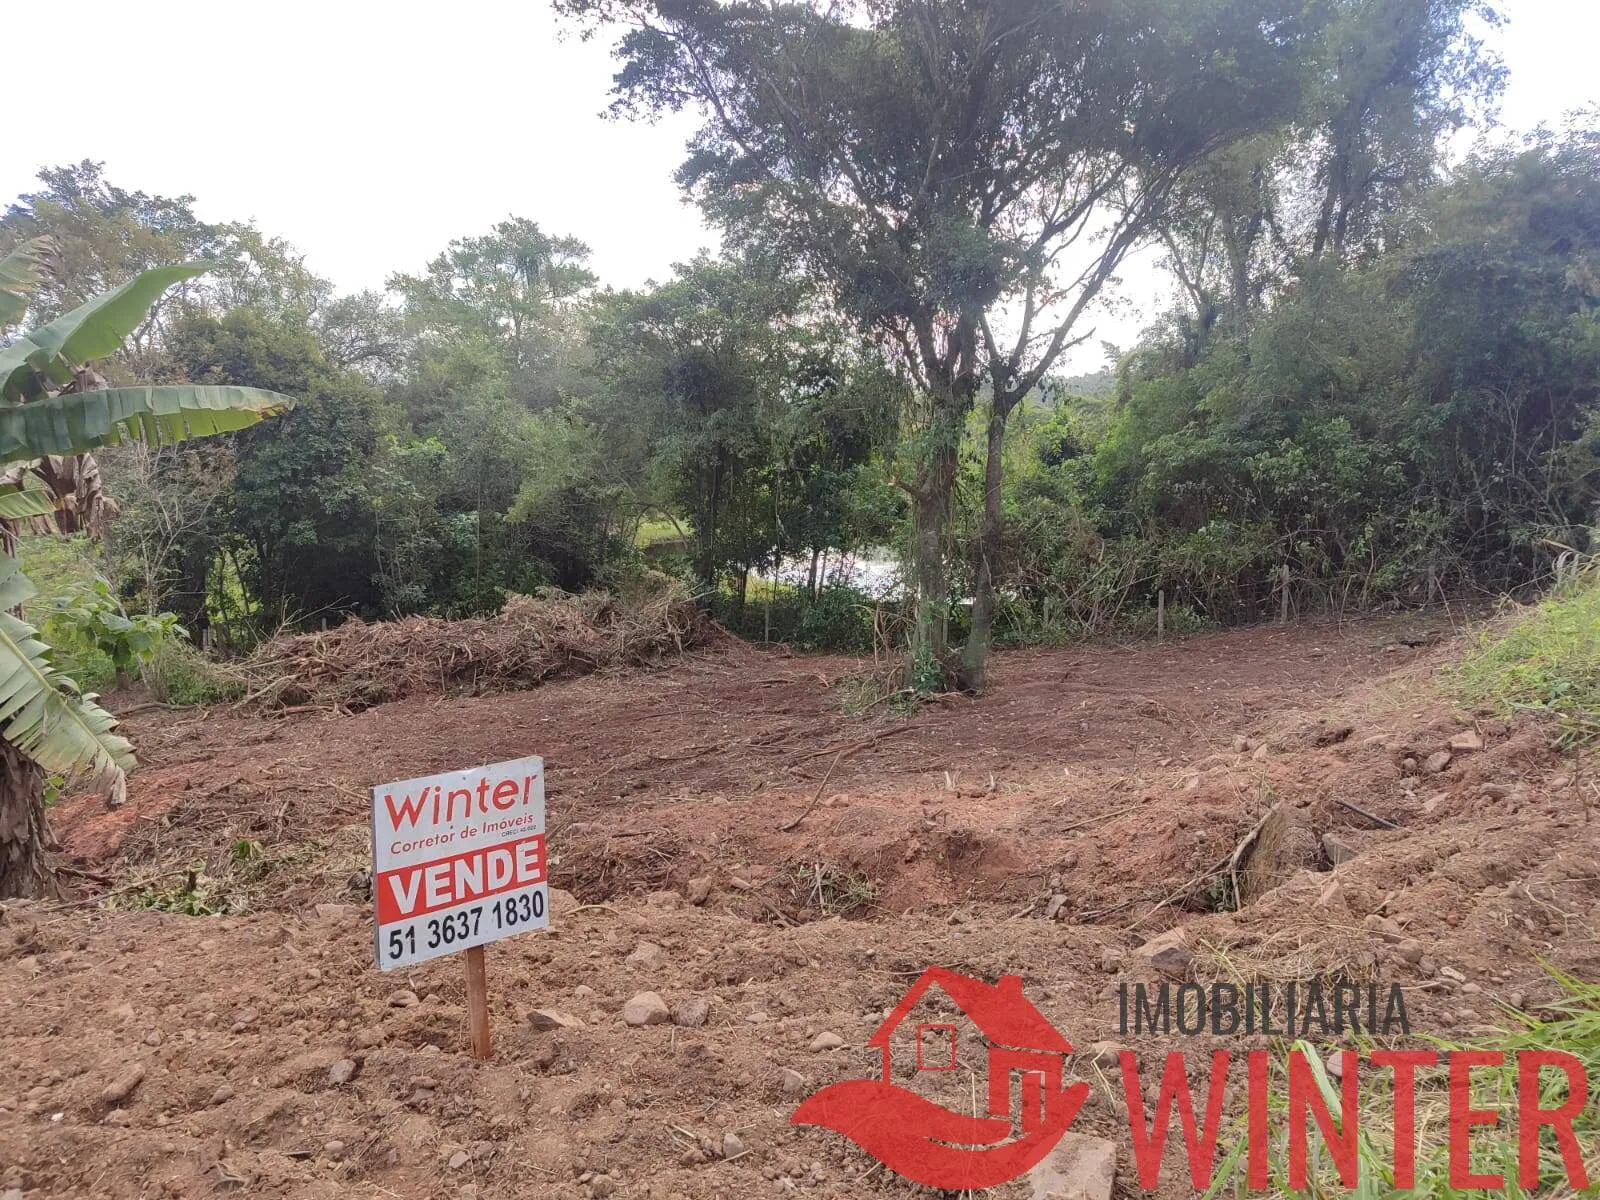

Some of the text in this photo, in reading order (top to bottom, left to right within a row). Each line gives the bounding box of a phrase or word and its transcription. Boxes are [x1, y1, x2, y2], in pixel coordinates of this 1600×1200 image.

[384, 774, 538, 832] Winter
[390, 812, 534, 855] Corretor de Imóveis
[388, 840, 541, 915] VENDE
[389, 890, 544, 960] 51 3637 1830
